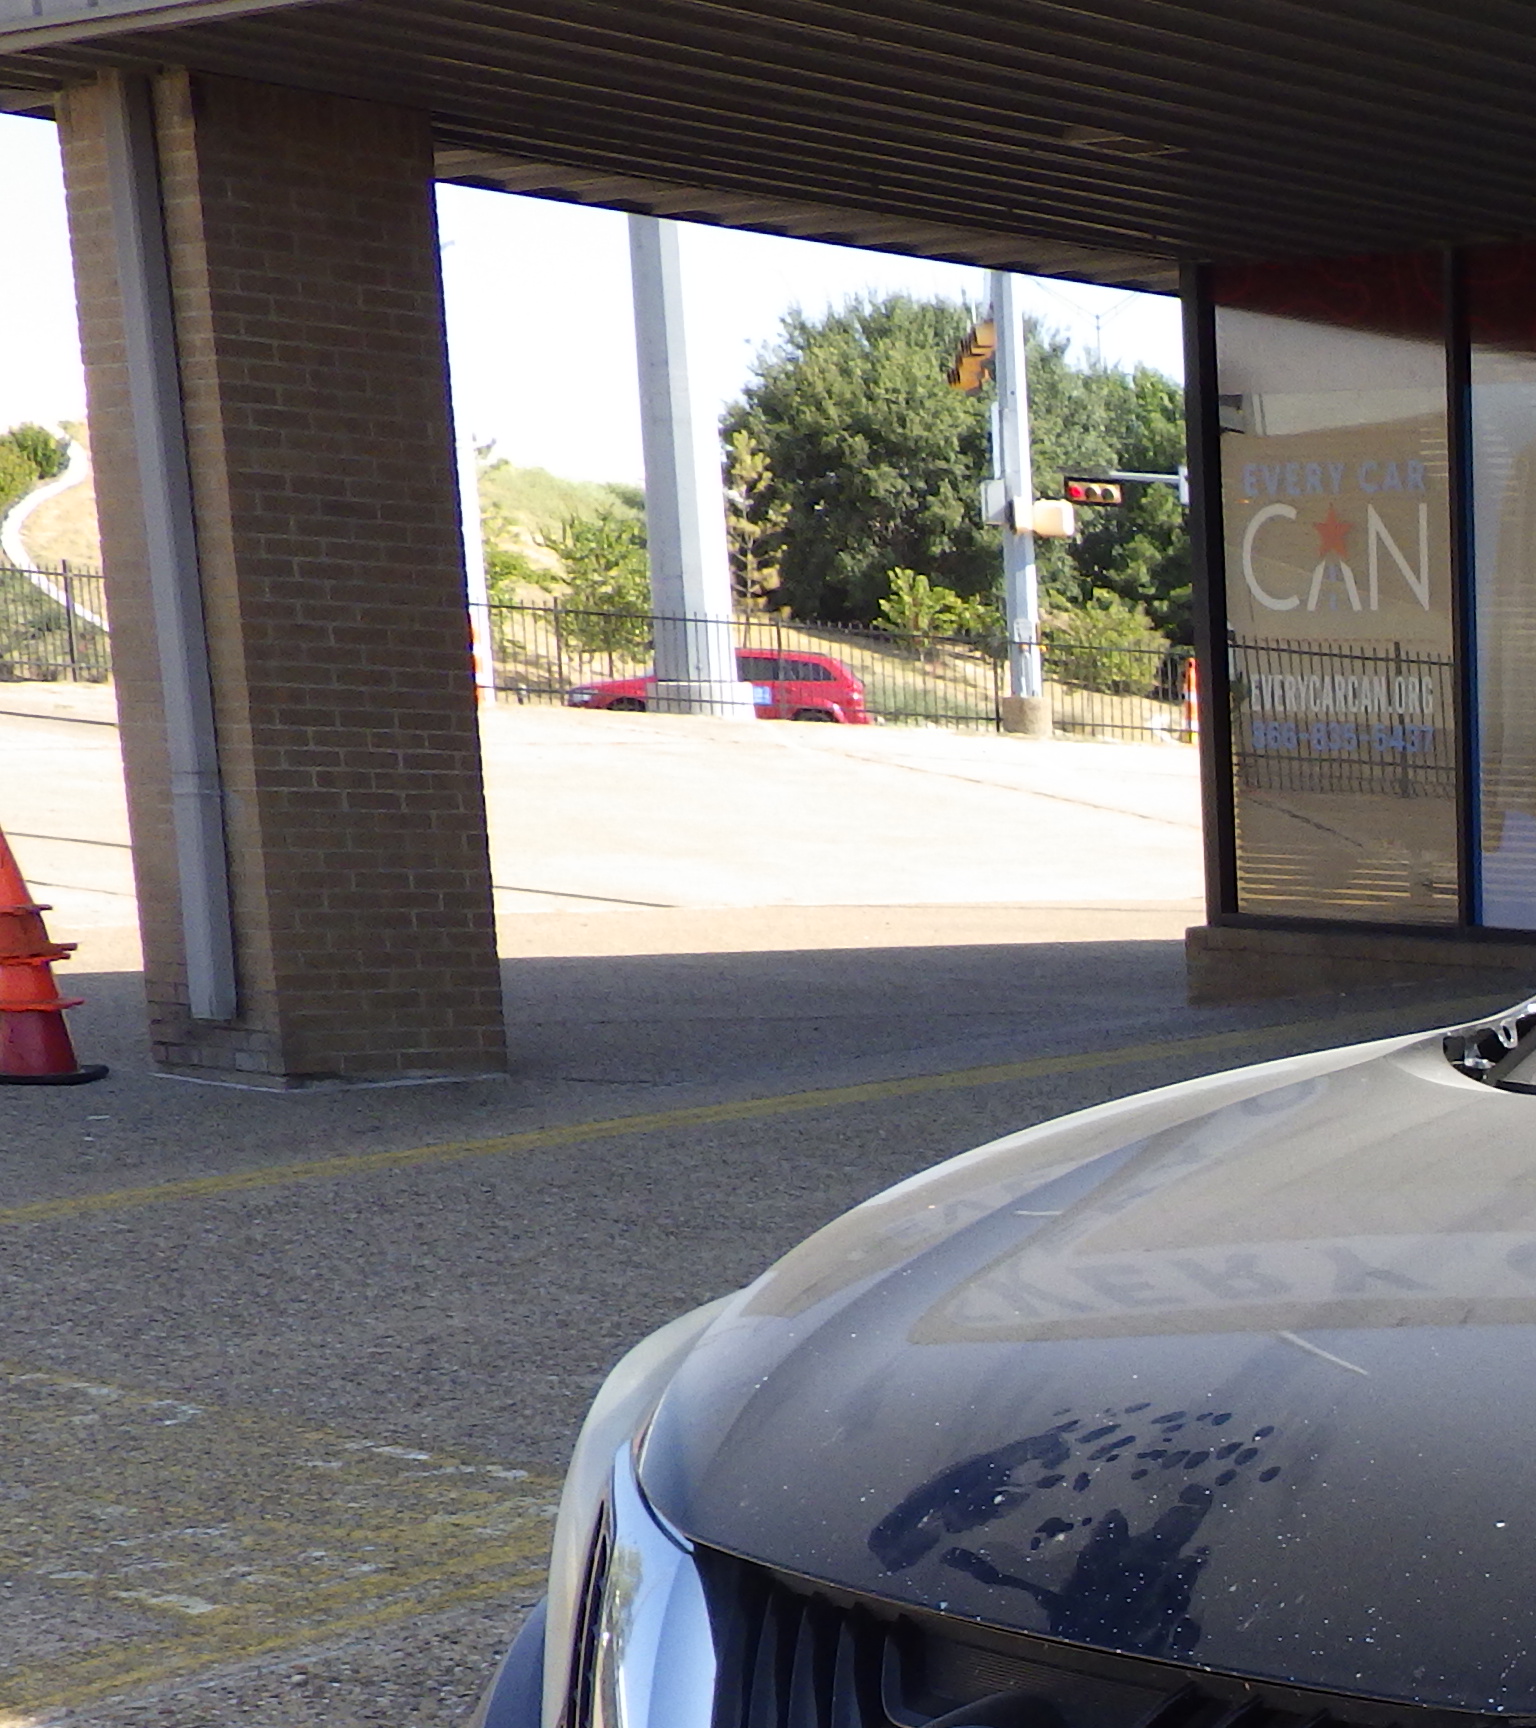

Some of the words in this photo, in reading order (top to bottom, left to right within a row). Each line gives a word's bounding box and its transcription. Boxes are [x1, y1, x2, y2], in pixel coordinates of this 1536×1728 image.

[1242, 462, 1345, 496] EVERY
[1359, 459, 1426, 493] CAR
[1242, 502, 1430, 611] CAN
[1250, 673, 1433, 714] EVERYCARCAN.ORG
[1251, 721, 1435, 754] 866-835-5437
